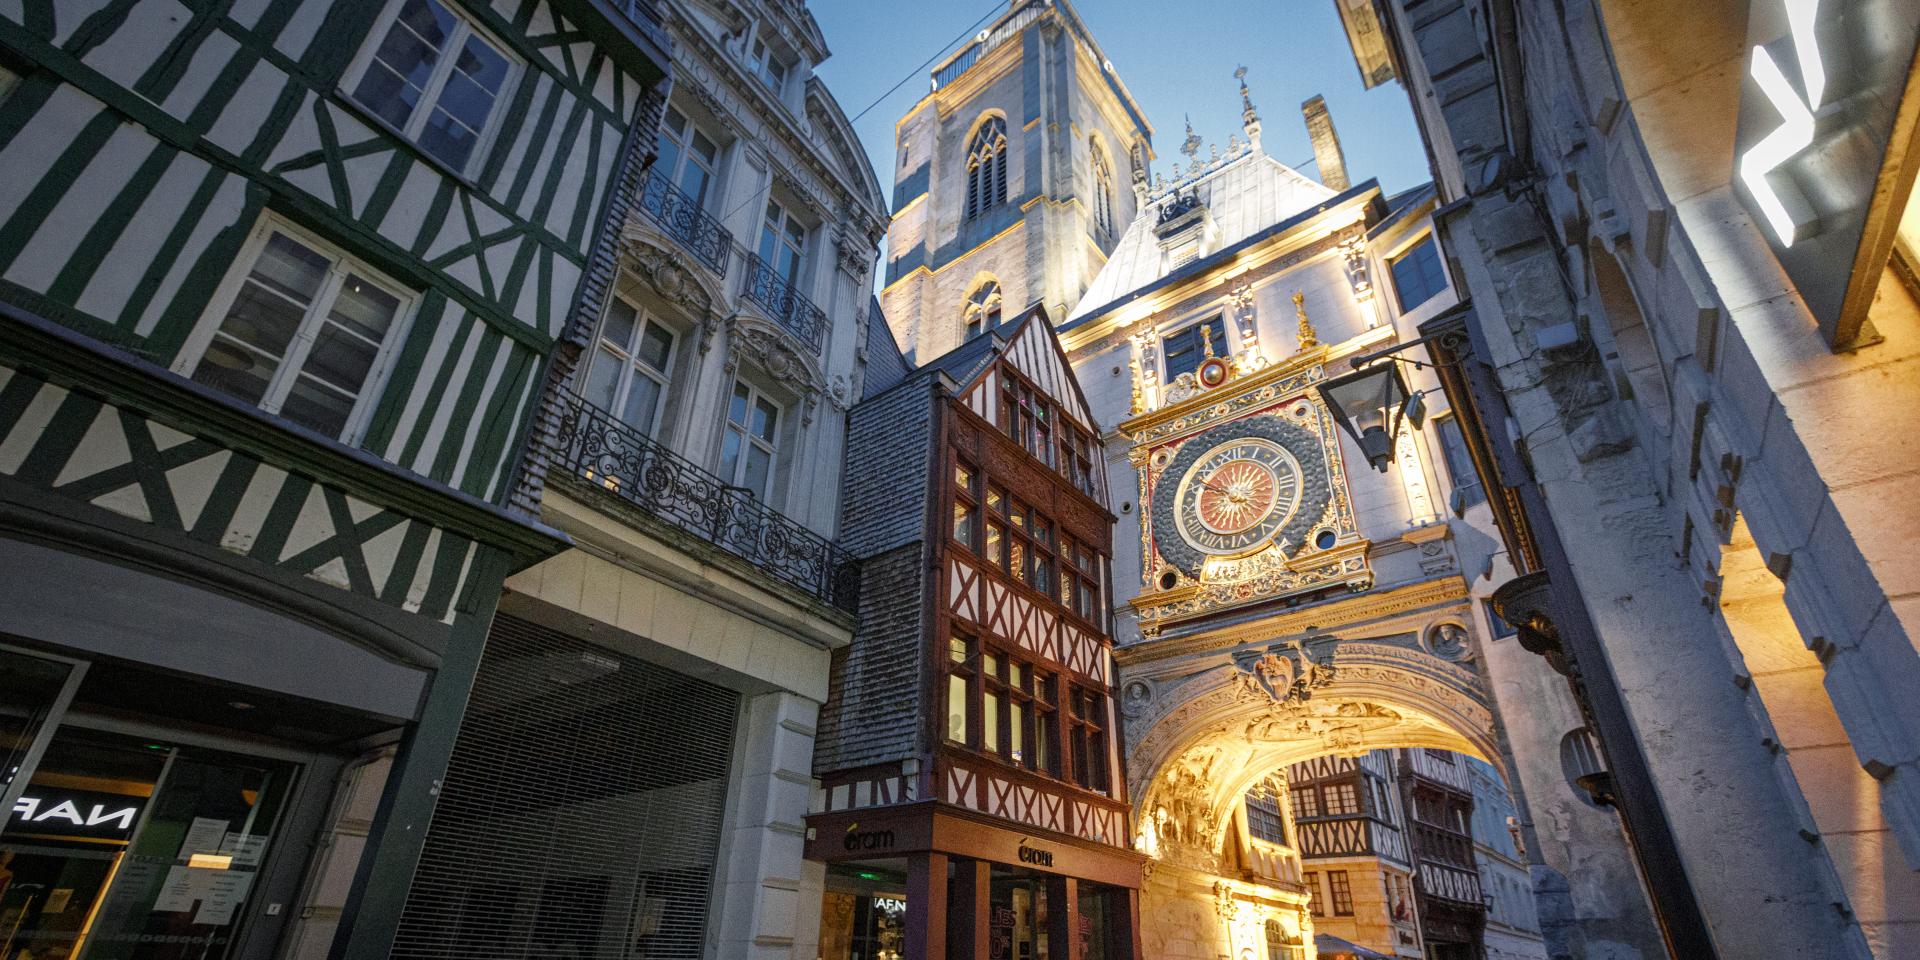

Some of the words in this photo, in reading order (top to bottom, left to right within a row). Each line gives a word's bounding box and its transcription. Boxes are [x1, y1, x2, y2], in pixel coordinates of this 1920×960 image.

[679, 50, 745, 122] HOTEL
[756, 123, 779, 155] DU
[786, 158, 830, 206] NORD
[843, 822, 895, 851] éram
[1018, 837, 1053, 868] éram
